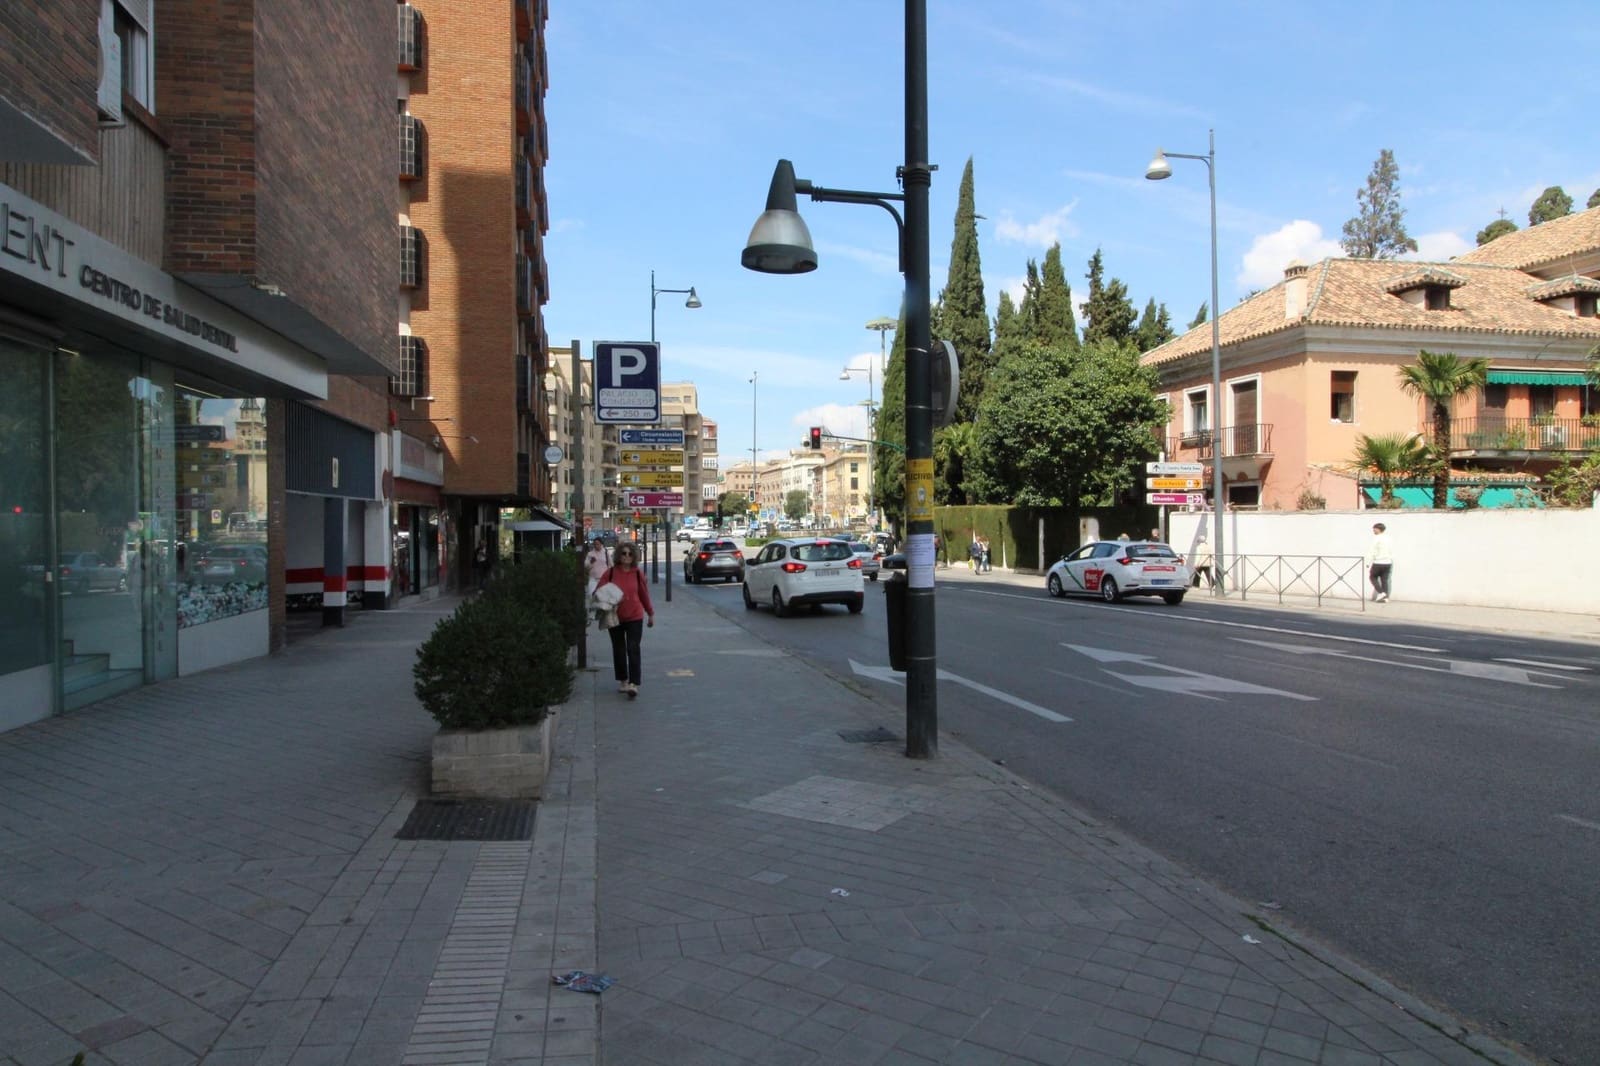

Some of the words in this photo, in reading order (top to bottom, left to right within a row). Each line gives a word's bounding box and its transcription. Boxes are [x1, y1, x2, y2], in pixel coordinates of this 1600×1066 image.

[79, 264, 142, 311] CENTRO
[143, 294, 164, 321] DE
[164, 303, 203, 337] SALUD
[202, 321, 242, 355] DENTAL
[611, 347, 647, 387] P
[601, 390, 638, 398] PALACIO
[601, 398, 655, 406] CONGRESOS
[623, 410, 639, 418] 250
